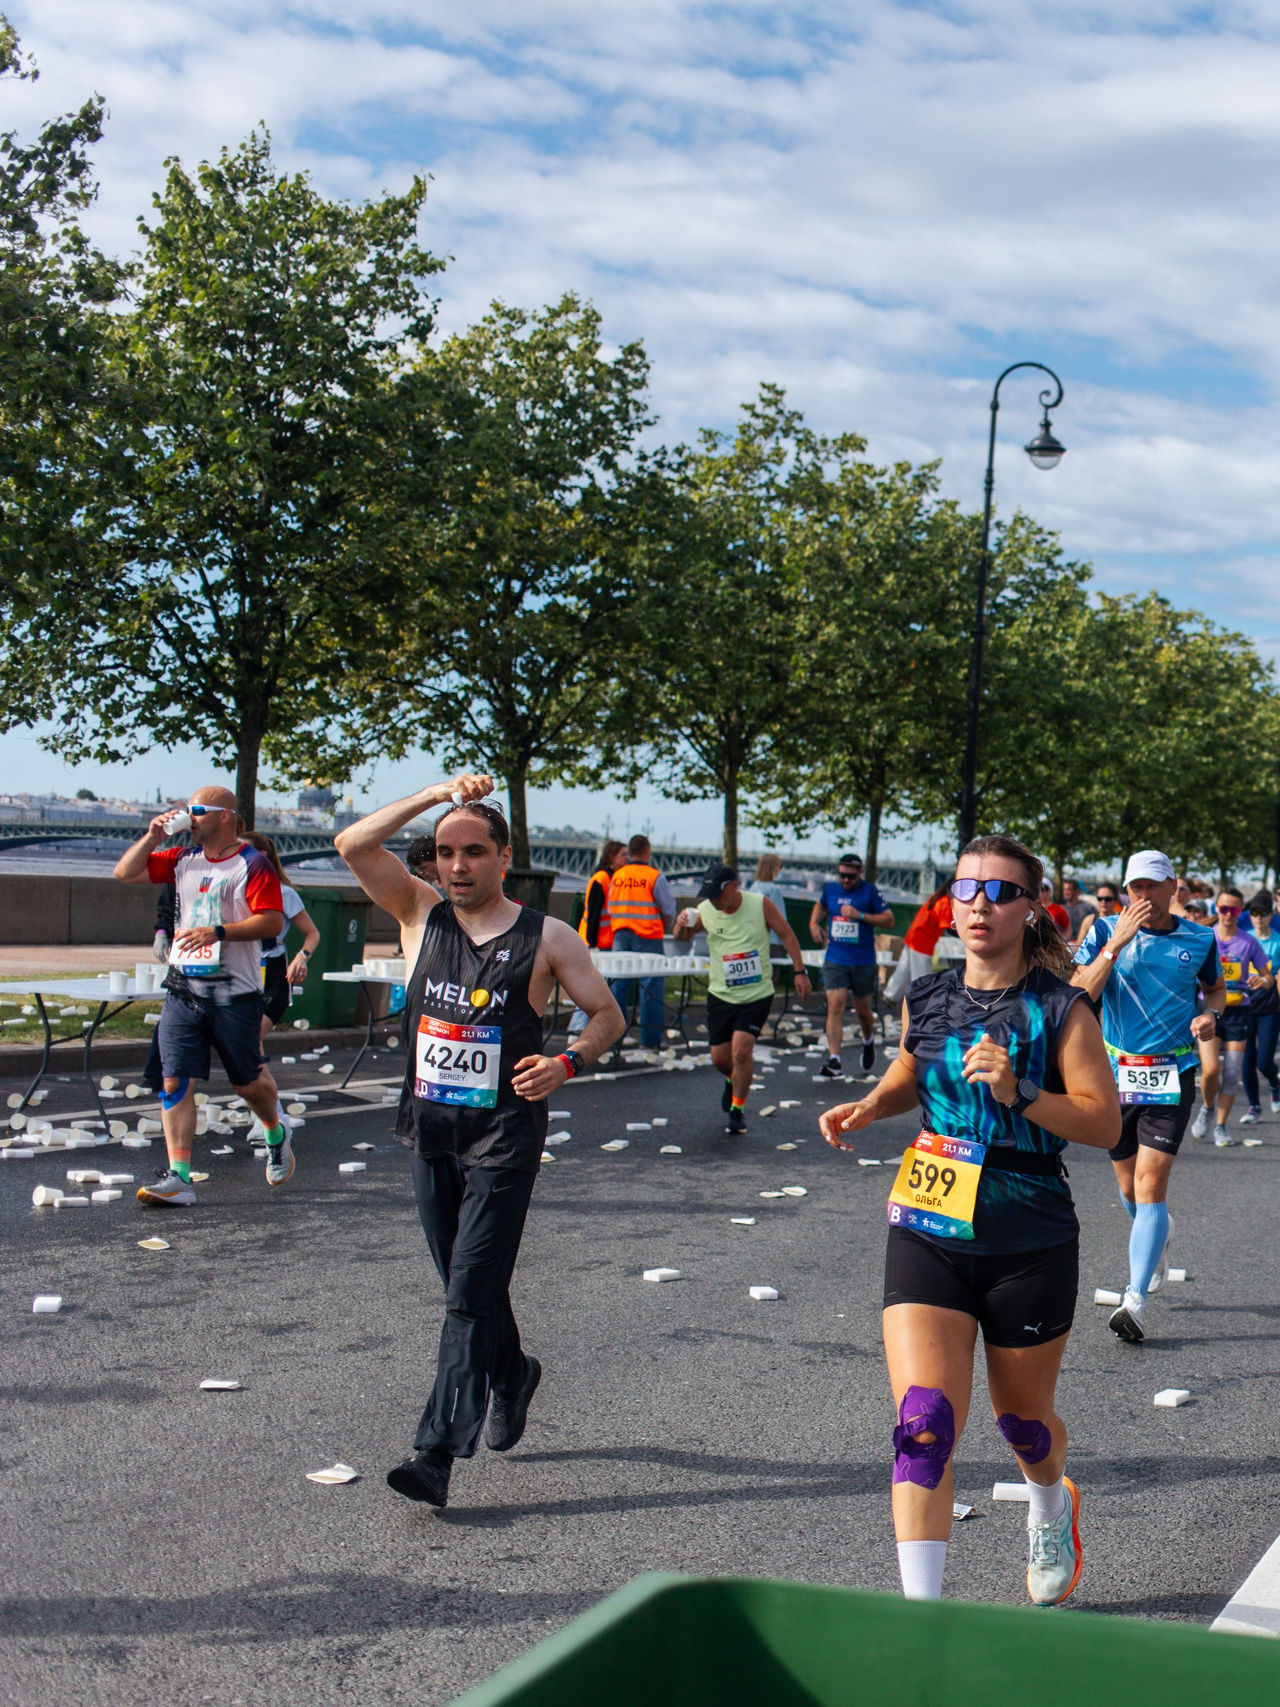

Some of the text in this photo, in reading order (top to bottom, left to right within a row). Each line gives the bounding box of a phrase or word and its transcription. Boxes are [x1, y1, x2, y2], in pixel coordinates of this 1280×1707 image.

[613, 877, 647, 889] СУДЬЯ
[729, 960, 756, 974] 3011
[424, 977, 509, 1008] MELON
[423, 999, 474, 1015] FASHION
[461, 1030, 475, 1039] 21,1
[424, 1043, 488, 1074] 4240
[439, 1072, 466, 1081] SERGEY
[1127, 1070, 1170, 1087] 5357
[421, 1081, 428, 1096] D
[1125, 1093, 1133, 1103] E
[942, 1143, 957, 1154] 21,1
[908, 1159, 957, 1197] 599
[915, 1194, 942, 1208] ОЛЬГА
[890, 1205, 901, 1222] B
